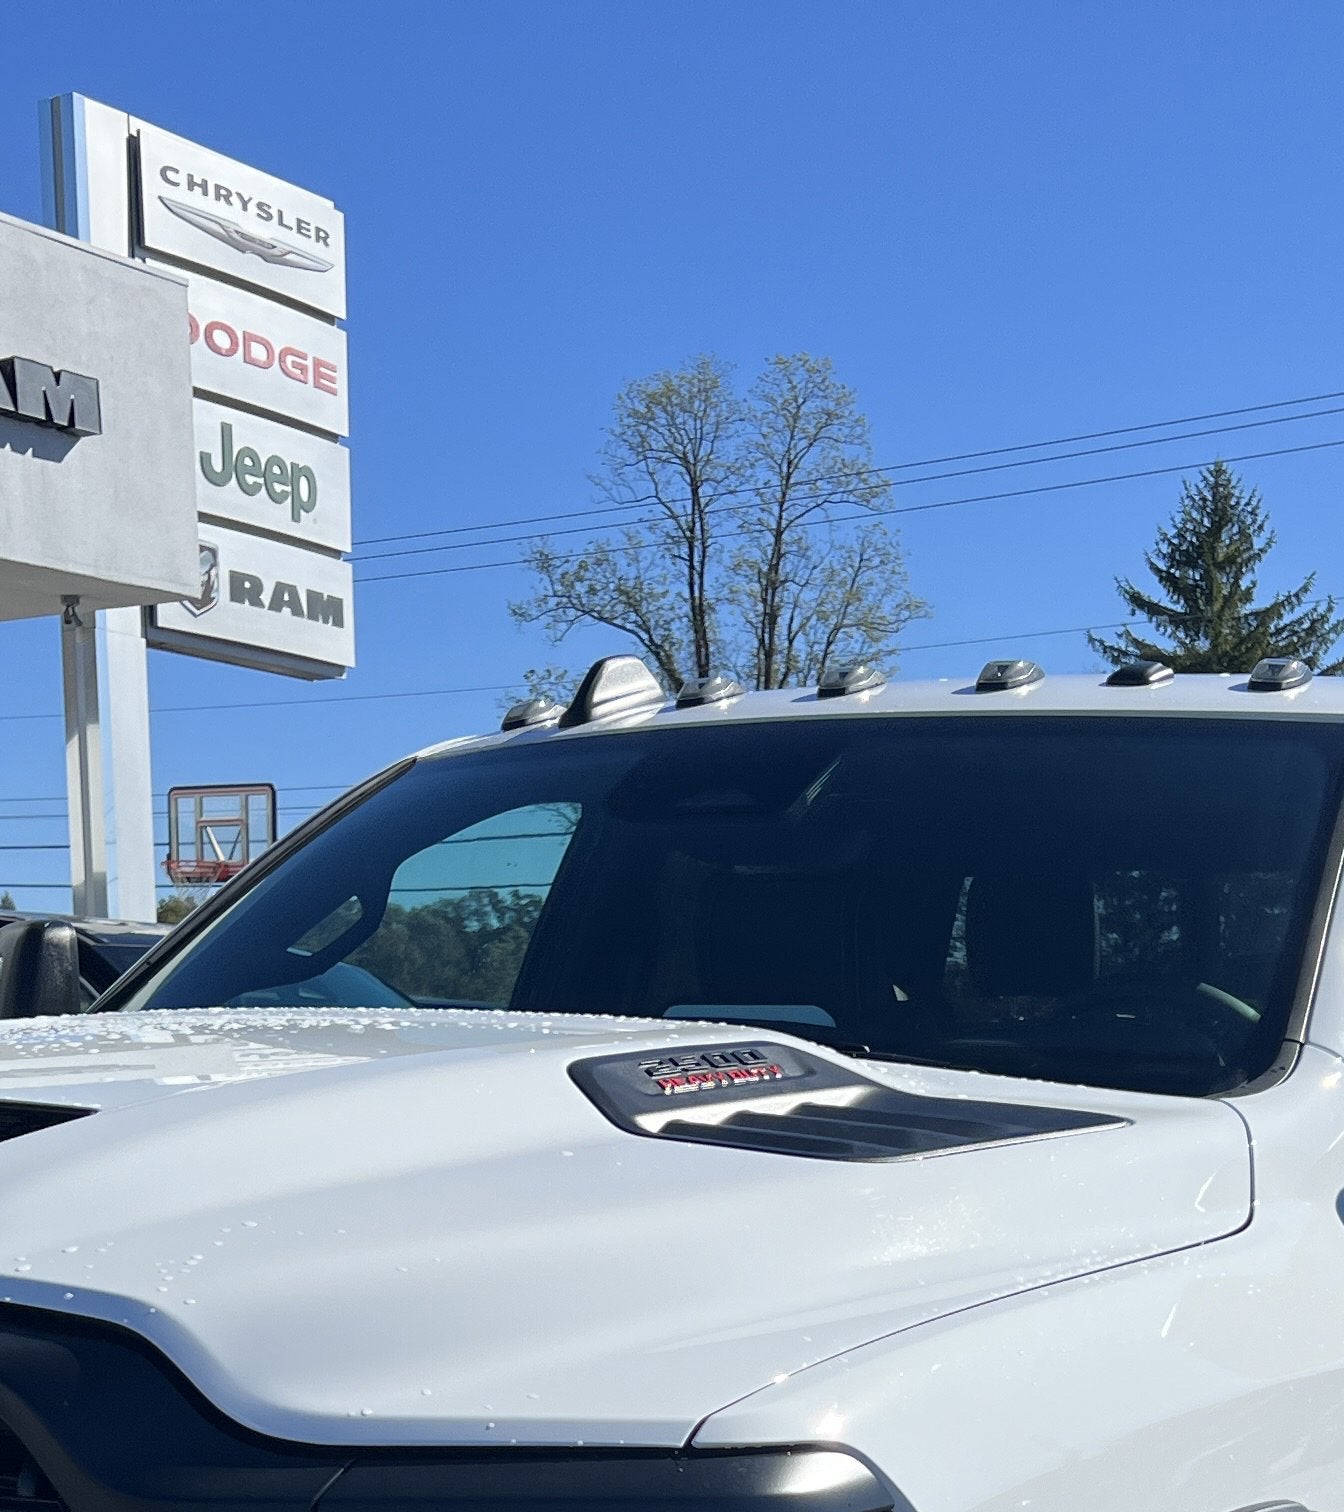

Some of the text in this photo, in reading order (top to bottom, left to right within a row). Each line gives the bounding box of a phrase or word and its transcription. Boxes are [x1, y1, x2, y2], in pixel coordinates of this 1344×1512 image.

[159, 165, 331, 248] CHRYSLER
[200, 421, 317, 523] Jeep
[229, 570, 344, 628] RAM
[639, 1049, 768, 1079] 2500
[656, 1064, 783, 1095] HEAVY DUTY
